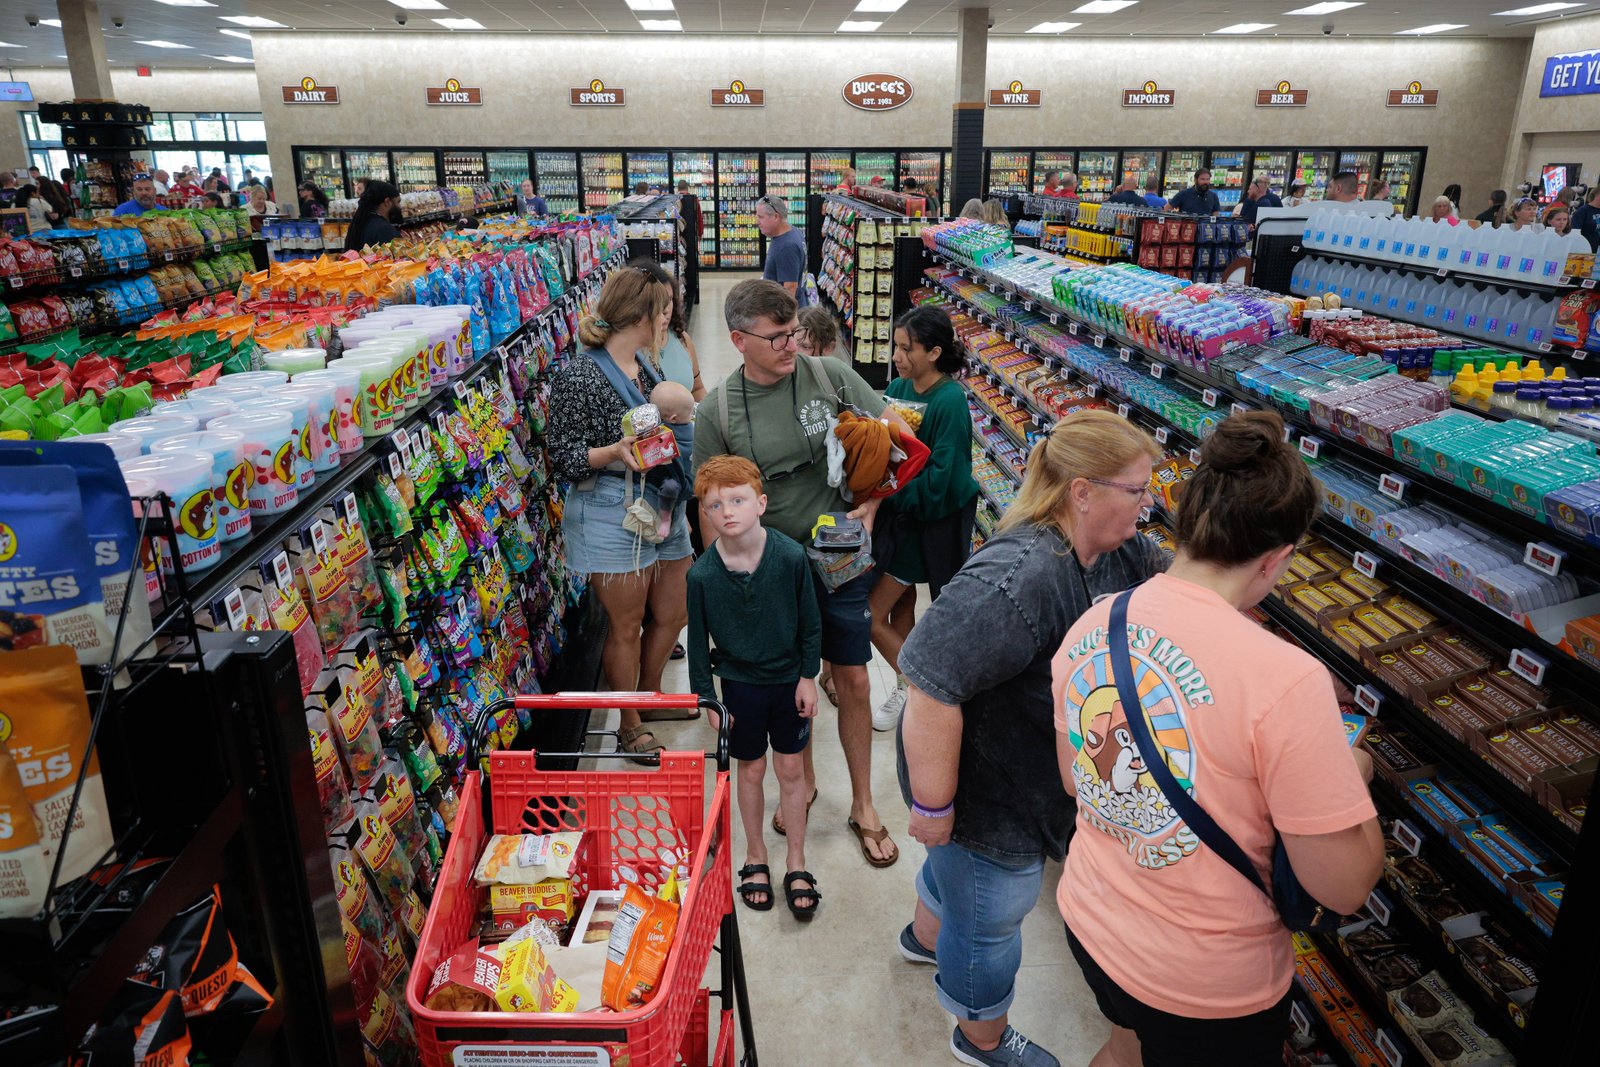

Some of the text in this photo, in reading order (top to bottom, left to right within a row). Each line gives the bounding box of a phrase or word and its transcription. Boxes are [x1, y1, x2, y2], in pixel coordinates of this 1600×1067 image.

[1550, 62, 1583, 89] GET
[294, 91, 327, 101] DAIRY
[439, 92, 469, 102] JUICE
[579, 93, 616, 103] SPORTS
[724, 94, 751, 104] SODA
[1003, 93, 1029, 104] WINE
[1128, 94, 1170, 104] IMPORTS
[1270, 94, 1294, 104] BEER
[1401, 94, 1425, 104] BEER
[1471, 482, 1492, 495] MINTS
[1511, 499, 1535, 514] MINTS
[181, 547, 212, 568] COTTON
[0, 566, 36, 578] TTY
[57, 629, 97, 644] CASHEW
[1149, 637, 1215, 710] MORE
[1135, 825, 1199, 870] LESS
[500, 885, 556, 896] BEAVER BUDDIES
[473, 957, 487, 986] BEAVER
[485, 962, 500, 993] CHIPS
[191, 970, 227, 1005] QUESO
